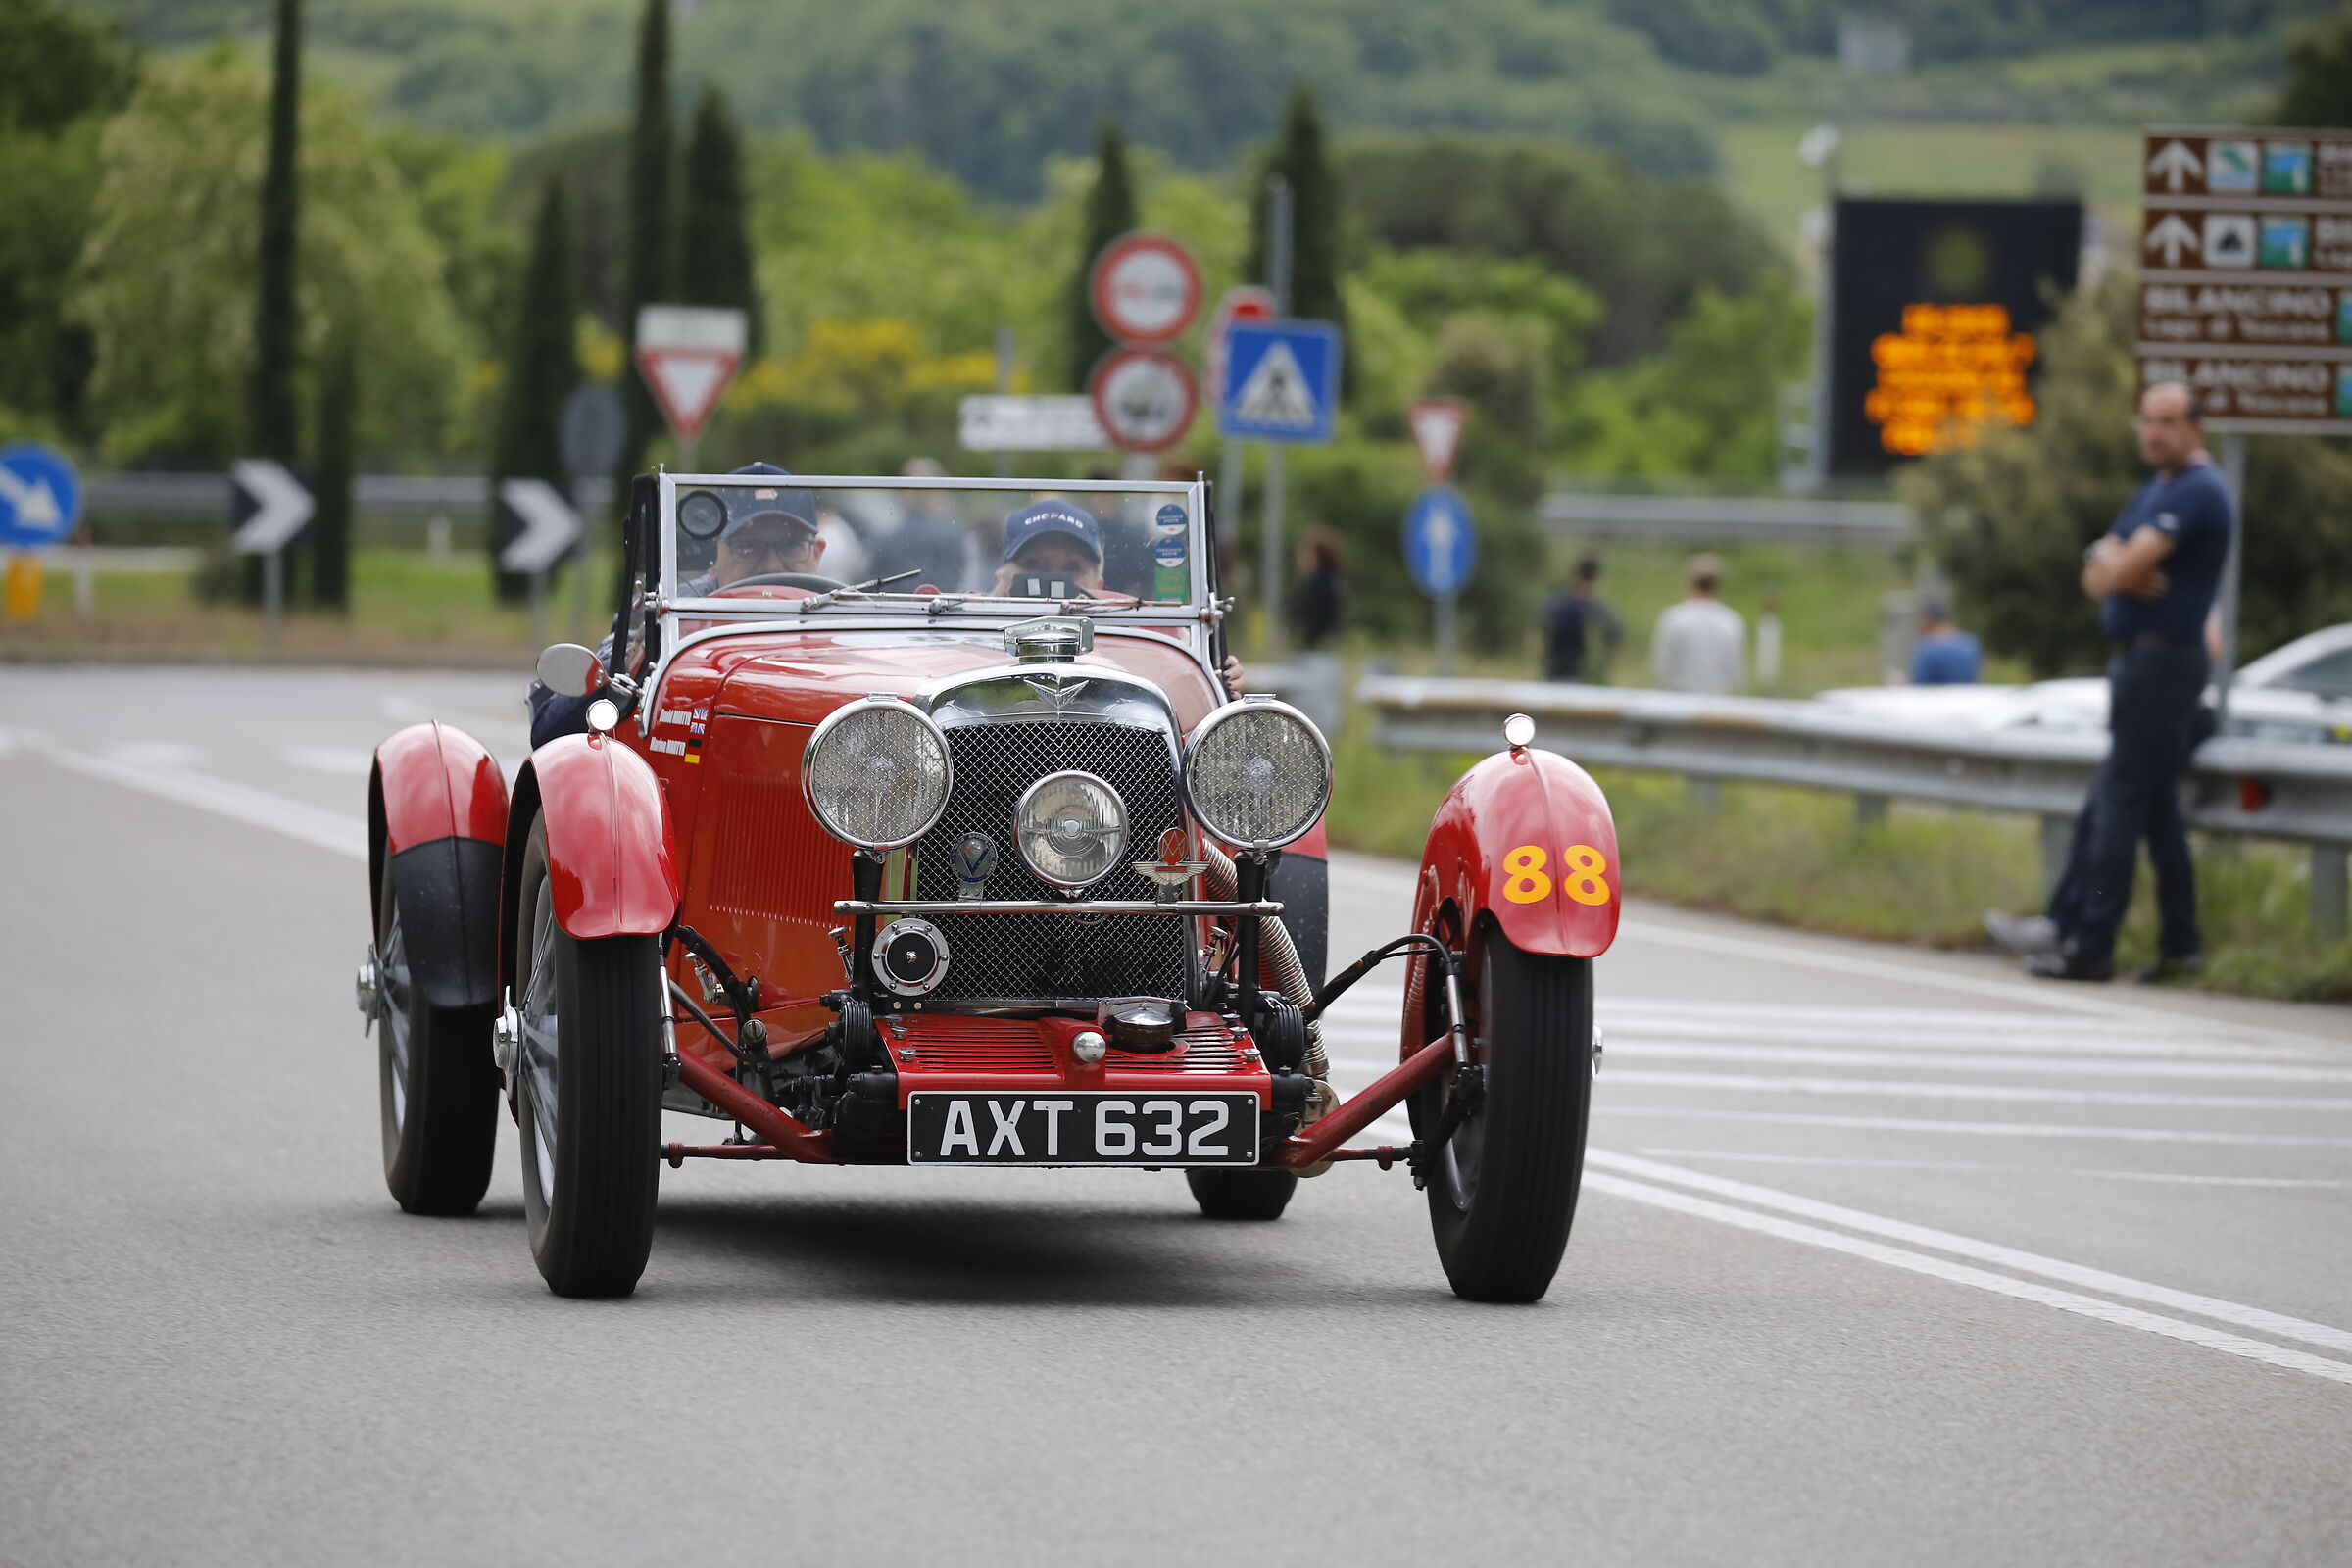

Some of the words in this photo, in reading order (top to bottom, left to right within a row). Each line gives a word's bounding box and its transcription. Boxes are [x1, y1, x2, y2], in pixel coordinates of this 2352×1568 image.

[2143, 286, 2332, 318] BILANCINO
[2142, 361, 2330, 392] BILANCINO
[1024, 513, 1084, 529] CHOPARD
[1502, 844, 1610, 906] 88
[940, 1101, 1074, 1156] AXT
[1095, 1101, 1229, 1156] 632
